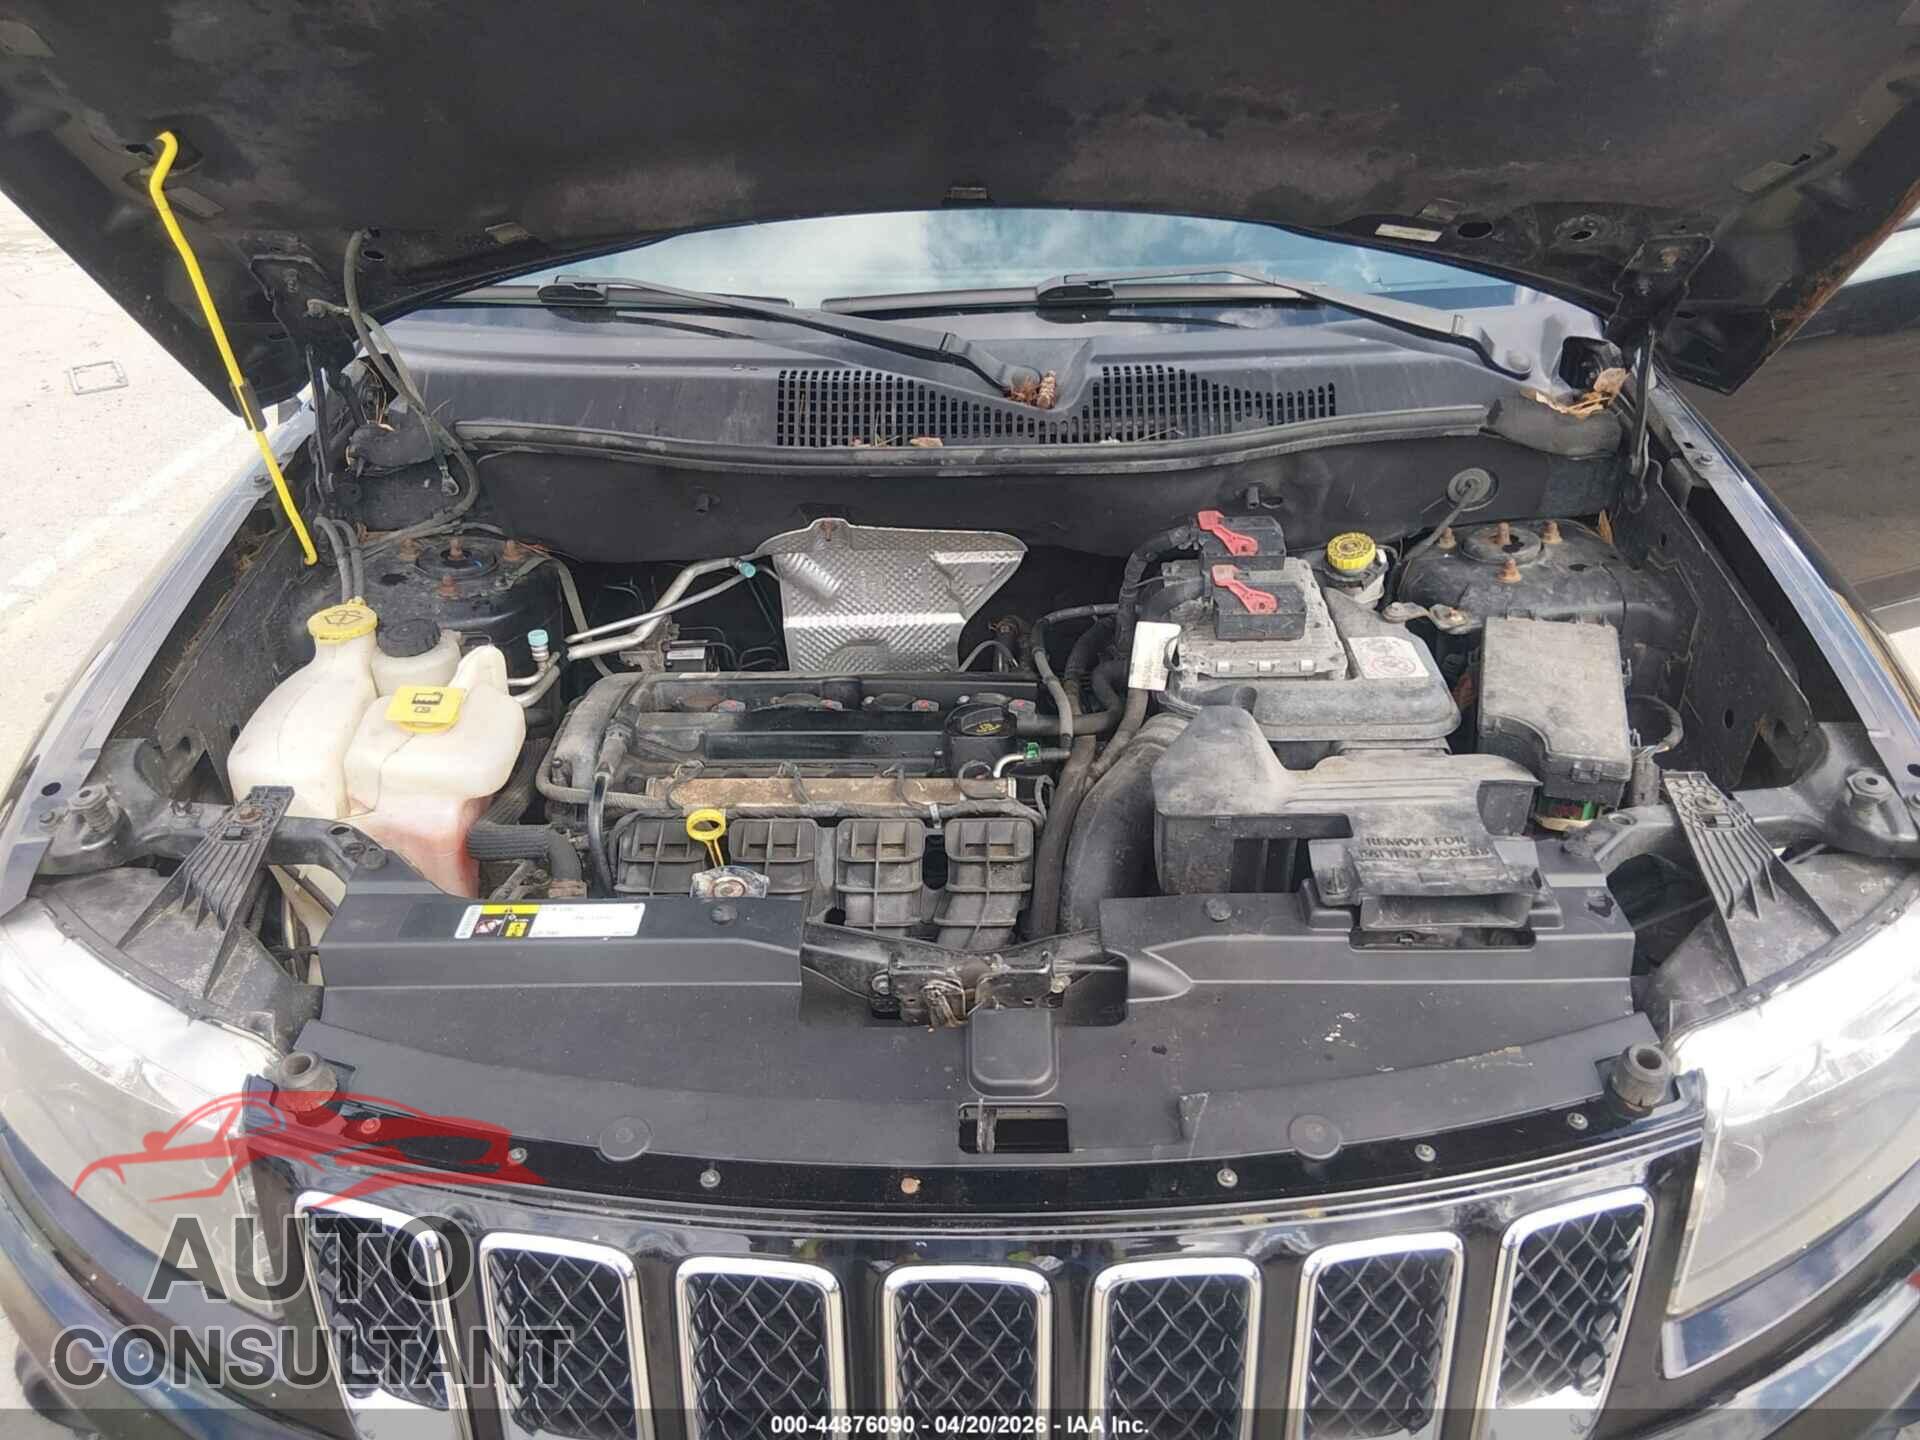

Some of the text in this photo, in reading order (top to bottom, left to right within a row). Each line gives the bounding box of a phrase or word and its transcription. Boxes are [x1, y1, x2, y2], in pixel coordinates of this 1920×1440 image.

[1366, 835, 1466, 846] REMOVE FOR
[1430, 847, 1490, 858] ACCESS
